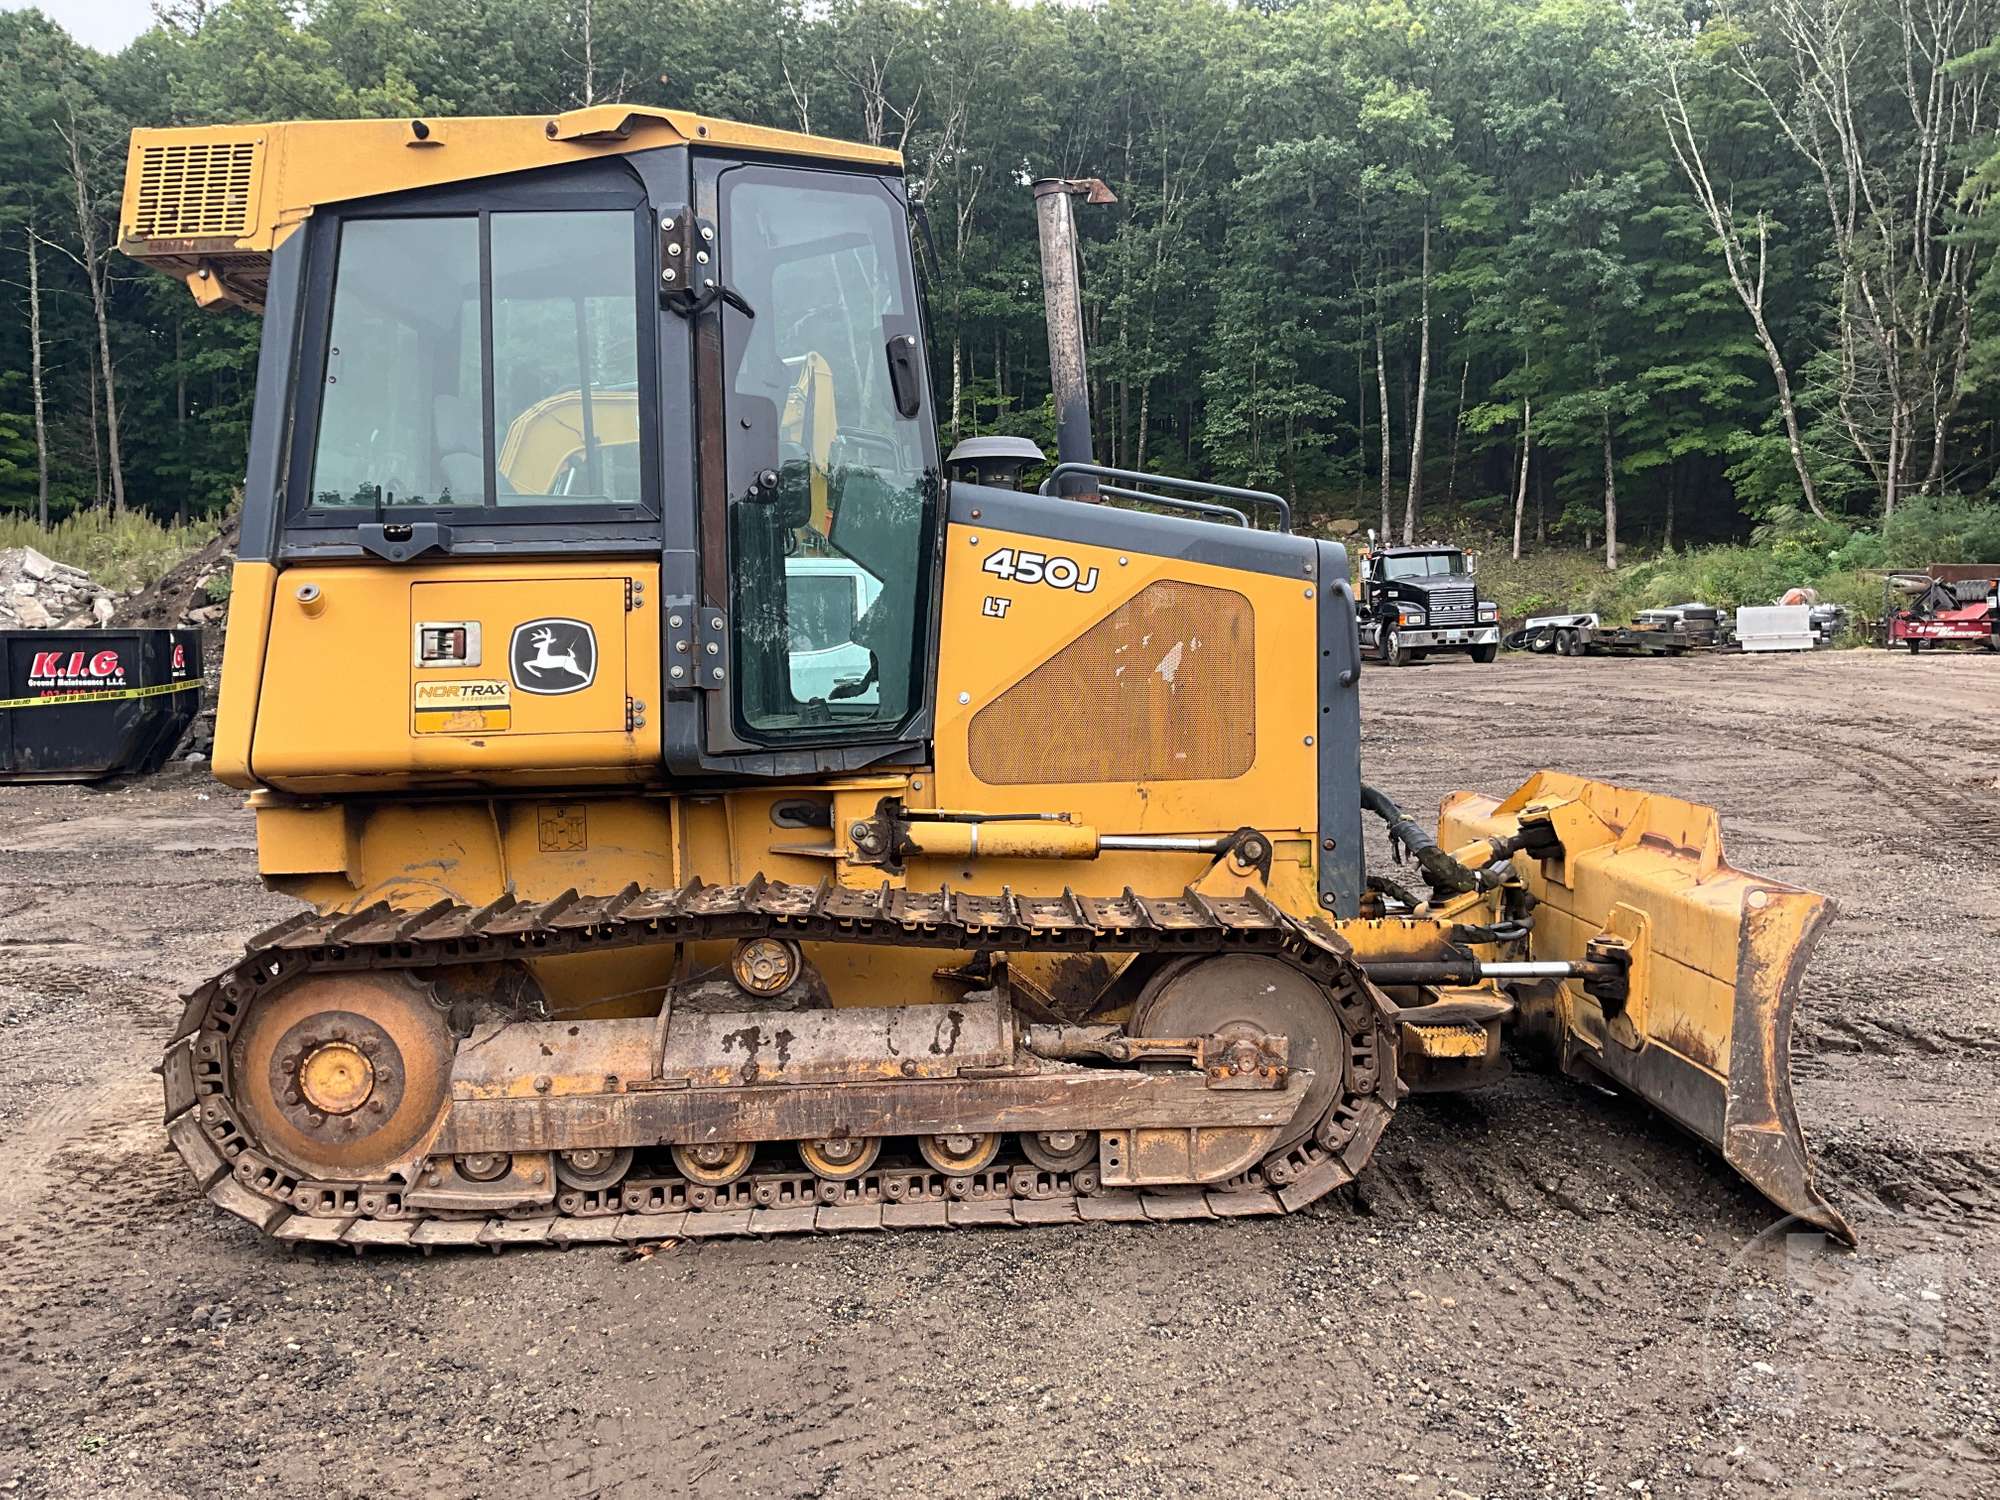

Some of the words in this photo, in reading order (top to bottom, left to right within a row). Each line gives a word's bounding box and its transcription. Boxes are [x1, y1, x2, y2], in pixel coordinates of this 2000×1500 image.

[982, 547, 1100, 593] 450J
[982, 595, 1012, 619] LT
[28, 678, 55, 687] Ground
[56, 678, 105, 687] Maintenance
[418, 684, 506, 698] NORTRAX
